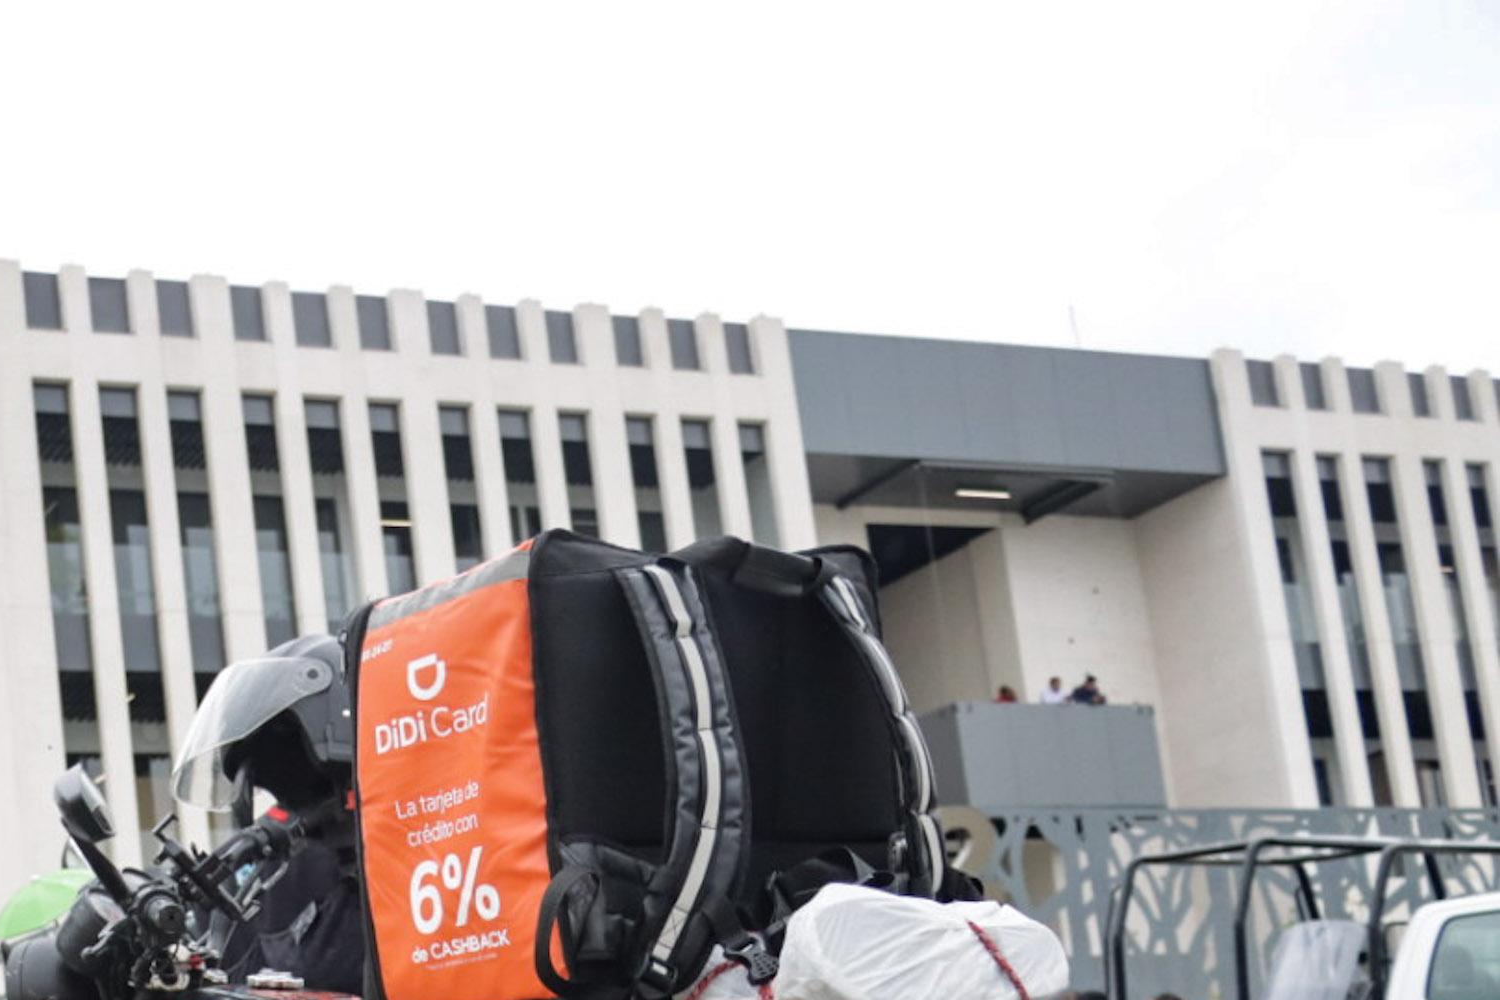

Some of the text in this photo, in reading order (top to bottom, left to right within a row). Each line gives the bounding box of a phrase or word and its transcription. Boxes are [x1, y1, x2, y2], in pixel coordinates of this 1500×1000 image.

[375, 691, 488, 754] DiDi Card
[395, 780, 479, 819] La tarjeta de
[455, 814, 479, 834] con
[409, 846, 501, 936] 6%
[412, 944, 429, 964] de
[430, 928, 511, 959] CASHBACK
